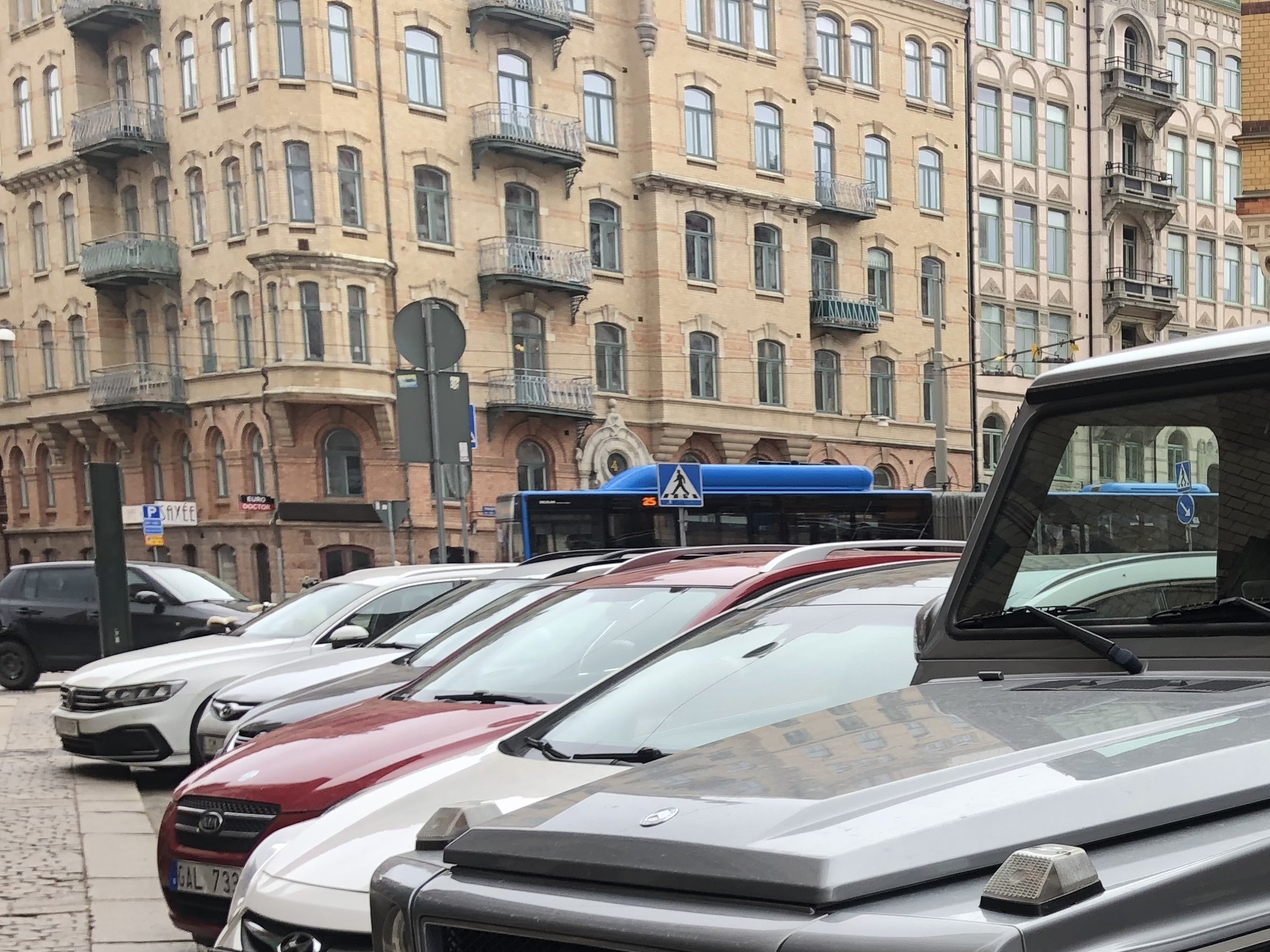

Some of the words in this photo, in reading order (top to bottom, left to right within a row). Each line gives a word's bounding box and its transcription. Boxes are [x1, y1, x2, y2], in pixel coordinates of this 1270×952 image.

[610, 460, 619, 472] 4
[246, 495, 267, 503] EURO
[147, 506, 157, 518] P
[242, 502, 271, 510] DOCTOR
[178, 865, 203, 890] GAL
